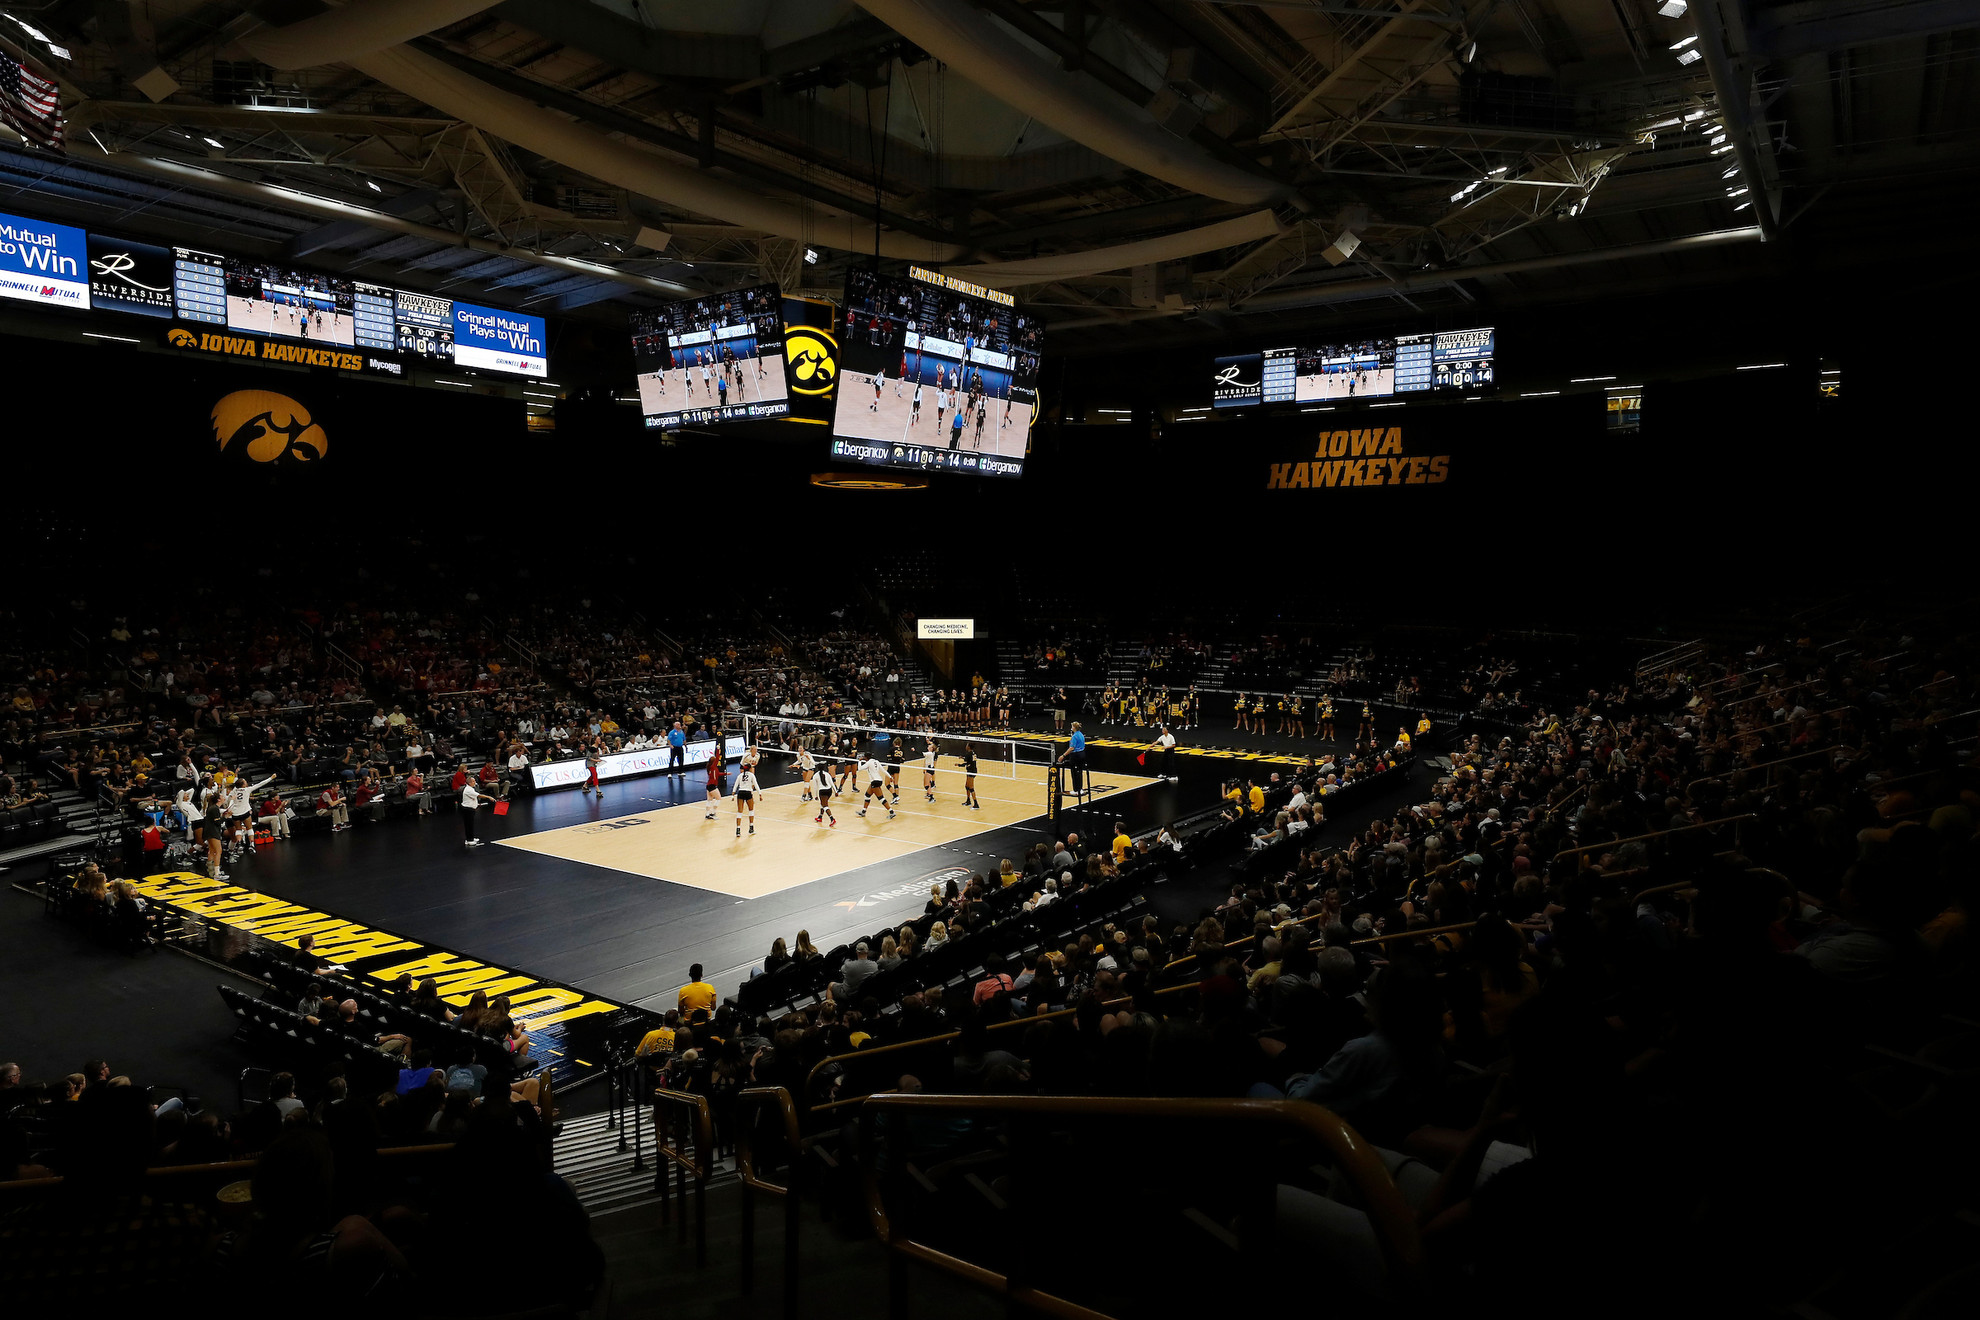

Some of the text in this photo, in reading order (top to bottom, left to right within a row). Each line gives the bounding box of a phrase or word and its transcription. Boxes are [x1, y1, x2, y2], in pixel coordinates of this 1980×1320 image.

[0, 224, 56, 248] Mutual
[18, 243, 78, 276] Win
[40, 286, 80, 299] MUTUAL
[92, 282, 172, 302] RIVERSIDE
[909, 266, 1014, 307] CARVER-HAWKEYE ARENA
[398, 293, 450, 311] HAWKEYES
[398, 304, 449, 318] HOME EVENTS
[457, 310, 496, 327] Grinnell
[497, 318, 529, 333] Mutual
[418, 328, 435, 337] 0:00
[469, 324, 540, 353] Plays to Win
[1436, 330, 1492, 345] HAWKEYES
[200, 333, 363, 371] IOWA HAWKEYES
[400, 337, 412, 348] 11
[428, 342, 433, 352] 0
[440, 343, 452, 354] 14
[369, 358, 401, 372] Mycogen
[1437, 374, 1449, 384] 11
[1464, 374, 1470, 382] 0
[1477, 371, 1490, 381] 14
[1214, 387, 1260, 396] RIVERSIDE
[692, 411, 702, 421] 11
[722, 408, 732, 418] 14
[1315, 427, 1403, 458] IOWA
[907, 448, 920, 463] 11
[948, 454, 959, 467] 14
[963, 457, 976, 467] 0:00
[1267, 455, 1450, 489] HAWKEYES
[870, 869, 968, 900] Mediacom
[124, 872, 424, 964] HAWKEYES
[367, 952, 620, 1032] IOWA
